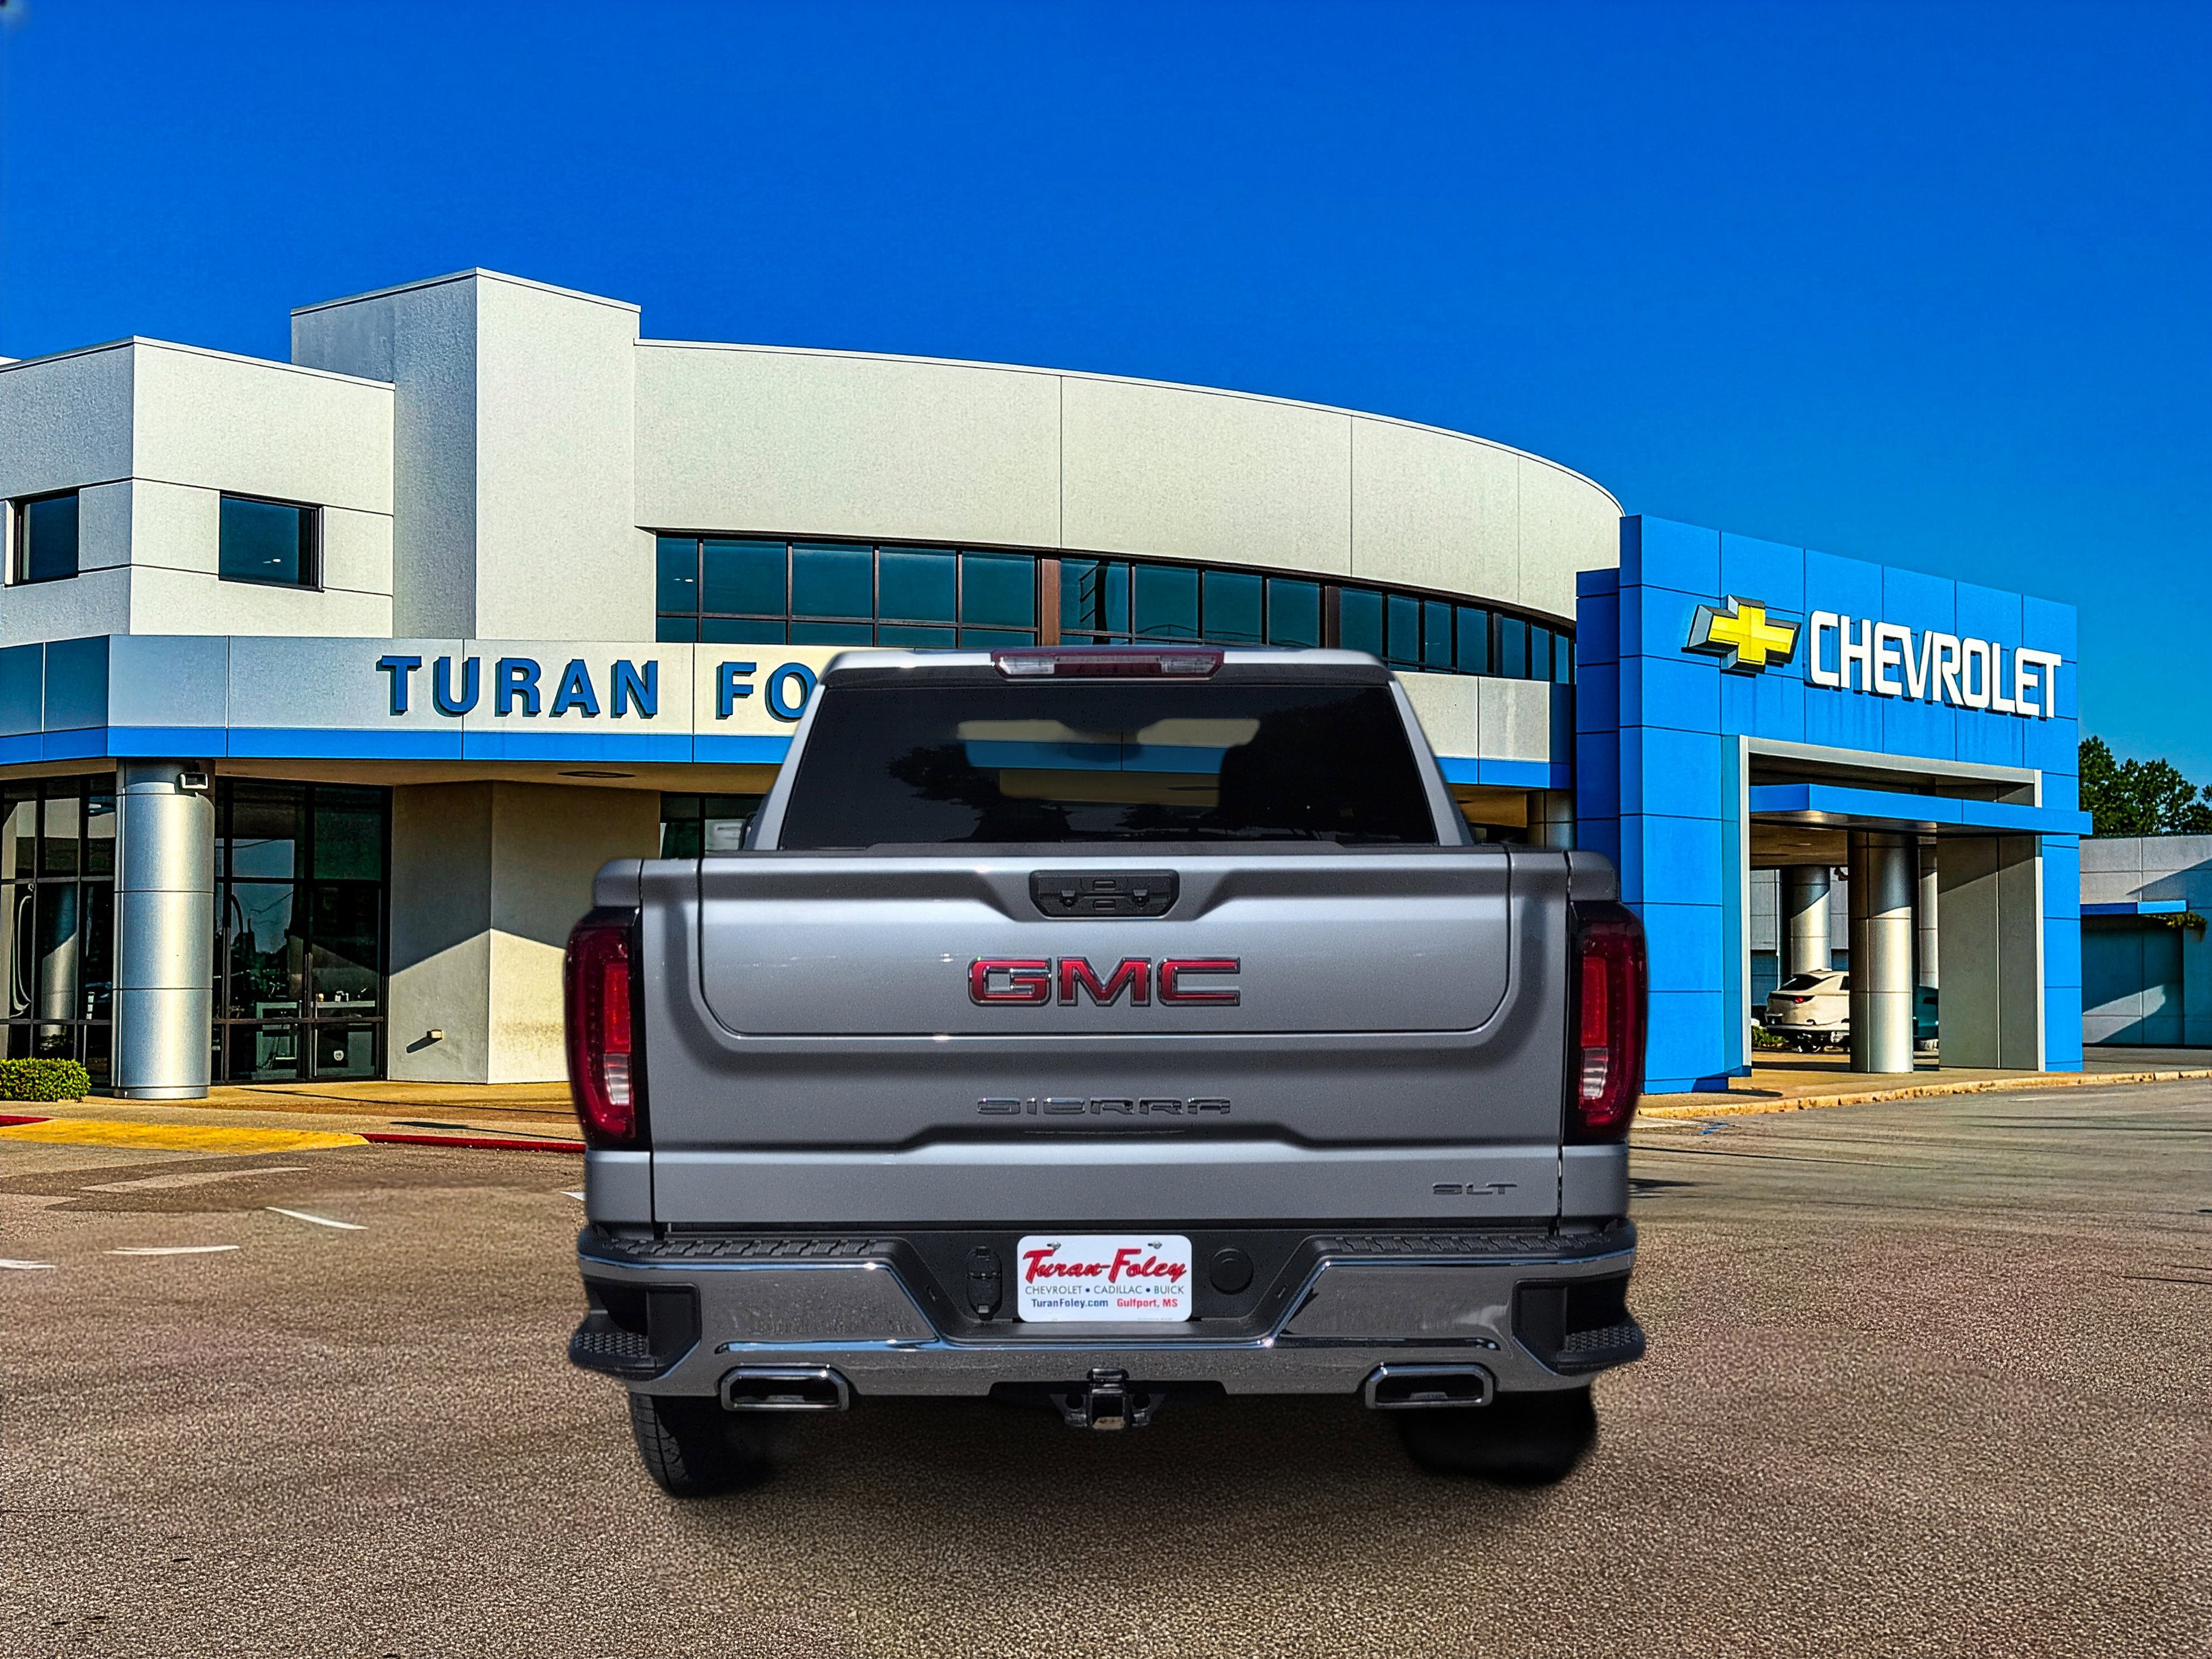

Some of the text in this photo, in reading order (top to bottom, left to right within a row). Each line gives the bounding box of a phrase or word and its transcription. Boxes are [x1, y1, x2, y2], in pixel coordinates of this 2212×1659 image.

[1809, 610, 2062, 718] CHEVROLET
[376, 655, 659, 719] TURAN
[968, 956, 1240, 1007] GMC
[977, 1097, 1231, 1115] SIERRA
[1432, 1182, 1517, 1195] SLT
[1023, 1248, 1187, 1284] Turan-Foley
[1025, 1285, 1185, 1295] CHEVROLET CADILLAC BUICK
[1031, 1298, 1178, 1308] TuranFoley.com Gulfport, MS
